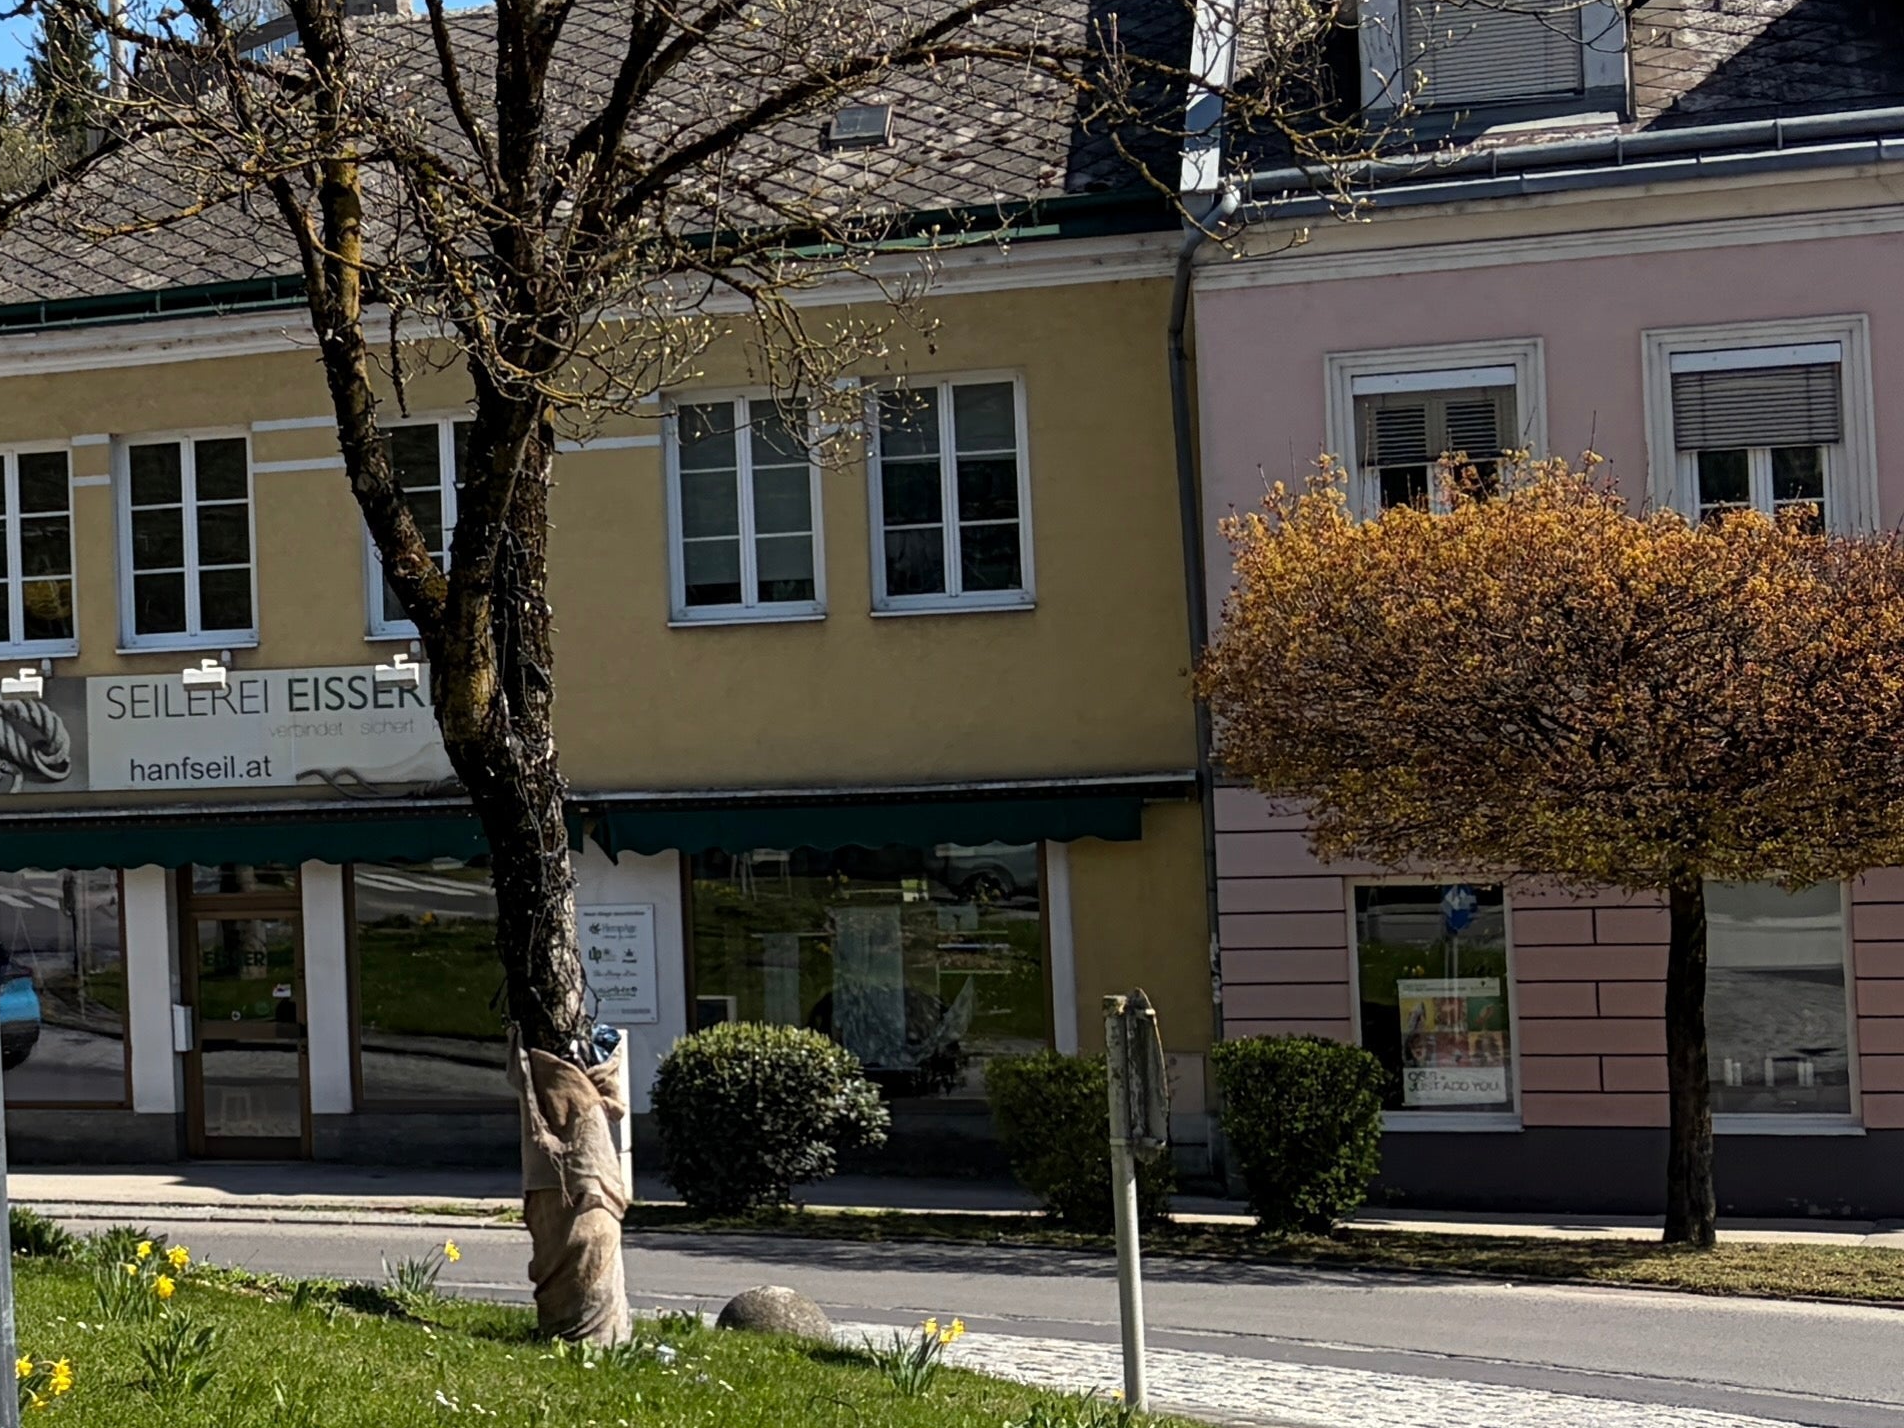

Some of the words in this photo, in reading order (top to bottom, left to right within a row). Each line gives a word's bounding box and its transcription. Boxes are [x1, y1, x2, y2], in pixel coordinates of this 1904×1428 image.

[106, 679, 269, 720] SEILEREI
[288, 675, 436, 712] EISSER
[130, 755, 272, 782] hanfseil.at
